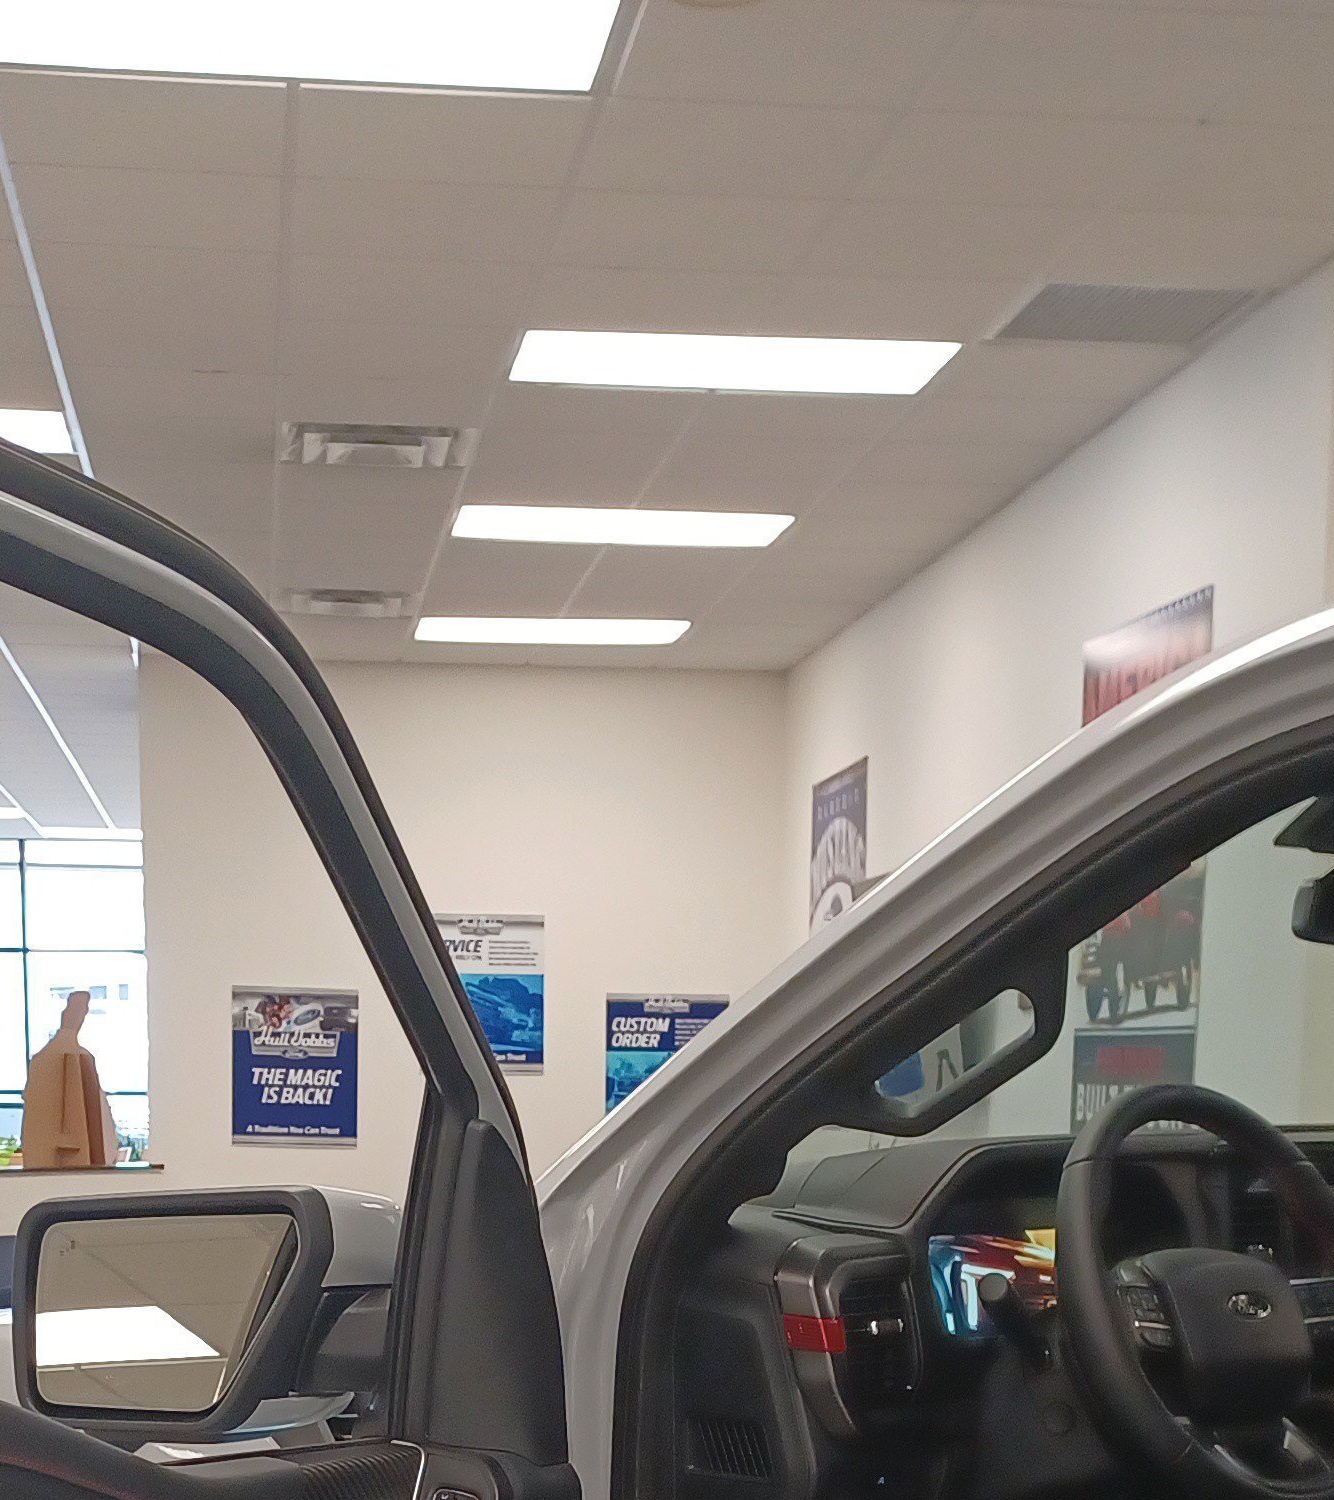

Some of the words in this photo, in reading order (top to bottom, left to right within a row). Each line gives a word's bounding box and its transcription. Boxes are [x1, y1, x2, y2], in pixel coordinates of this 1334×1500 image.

[611, 1017, 670, 1033] CUSTOM
[254, 1025, 289, 1046] Hull
[611, 1033, 660, 1048] ORDER
[252, 1067, 286, 1085] THE
[287, 1069, 342, 1087] MAGIC
[261, 1086, 279, 1104] IS
[280, 1087, 333, 1105] BACK!
